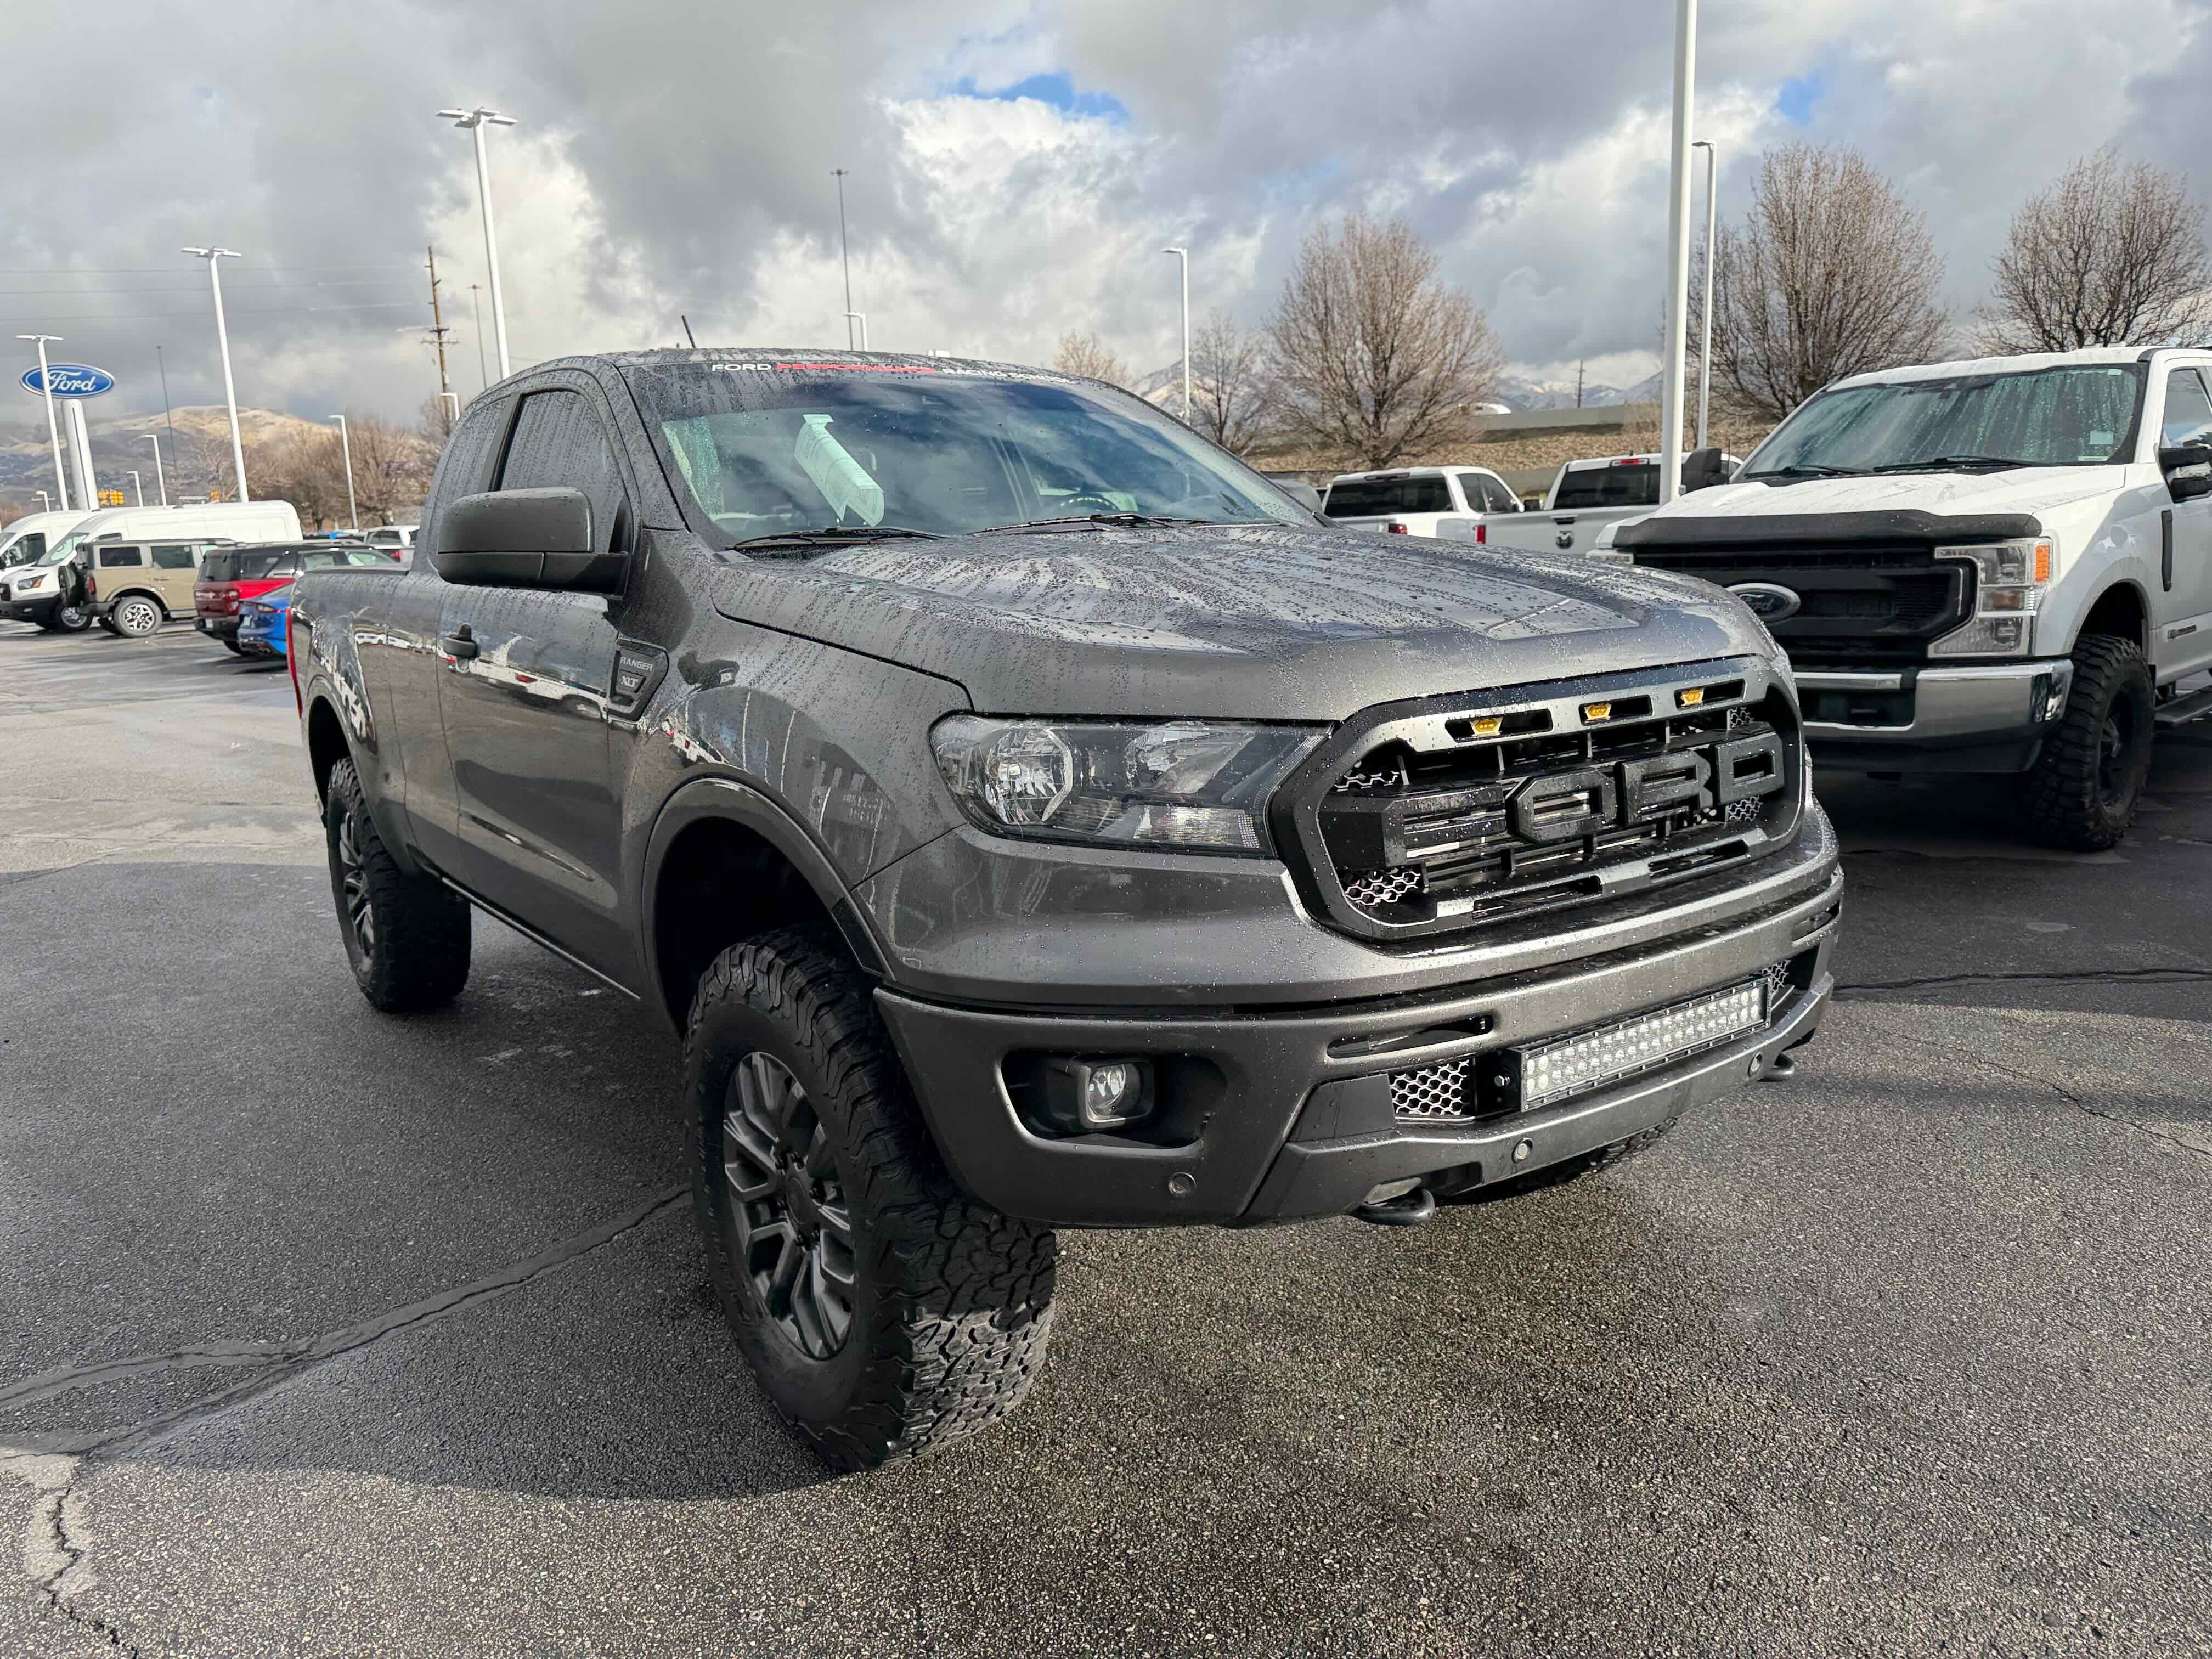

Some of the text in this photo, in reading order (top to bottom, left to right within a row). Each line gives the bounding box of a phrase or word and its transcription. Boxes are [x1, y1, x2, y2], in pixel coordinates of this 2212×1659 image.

[712, 363, 772, 372] FORD
[47, 370, 97, 391] Ford
[620, 657, 653, 672] RANGER
[620, 675, 639, 687] XLT
[1378, 725, 1787, 869] FORD
